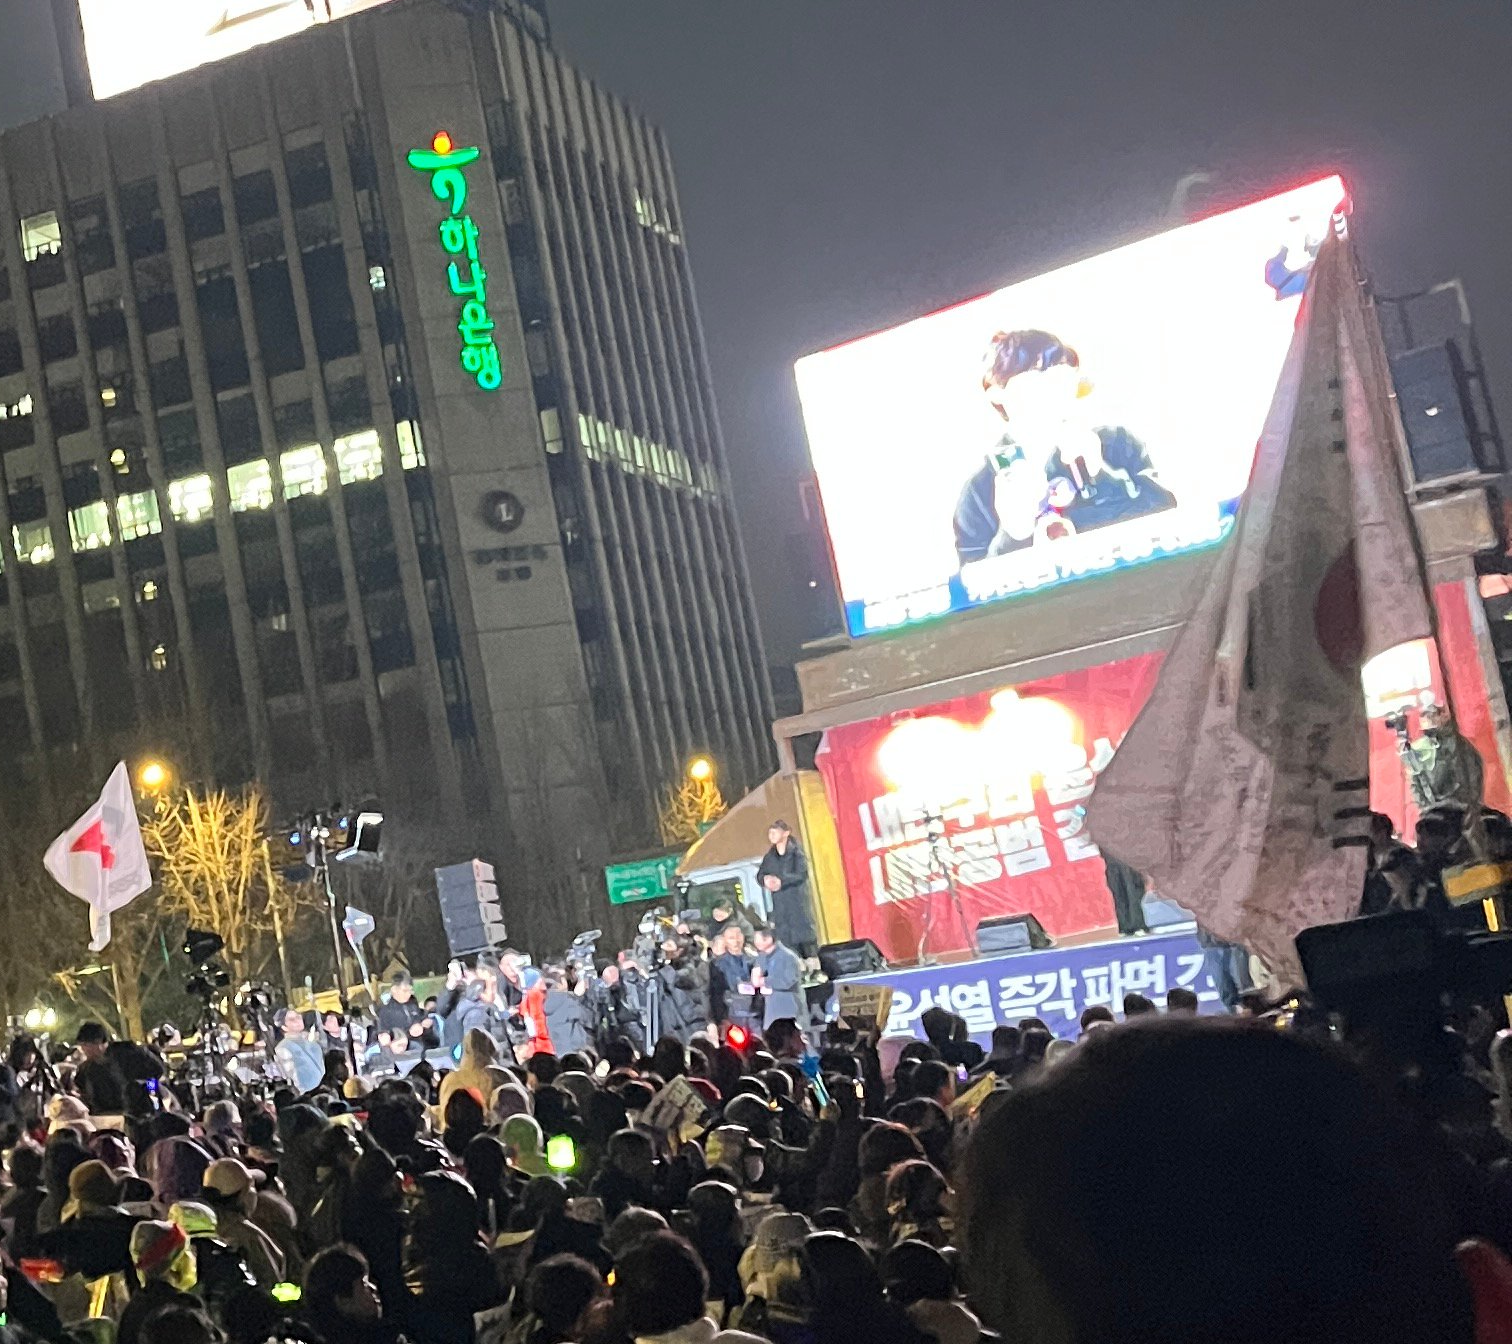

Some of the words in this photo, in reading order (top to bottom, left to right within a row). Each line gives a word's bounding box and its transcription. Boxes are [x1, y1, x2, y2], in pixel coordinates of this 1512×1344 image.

[439, 215, 503, 392] 하나은행
[882, 978, 998, 1040] 윤석열
[999, 967, 1078, 1021] 즉각
[1081, 954, 1167, 1015] 파면
